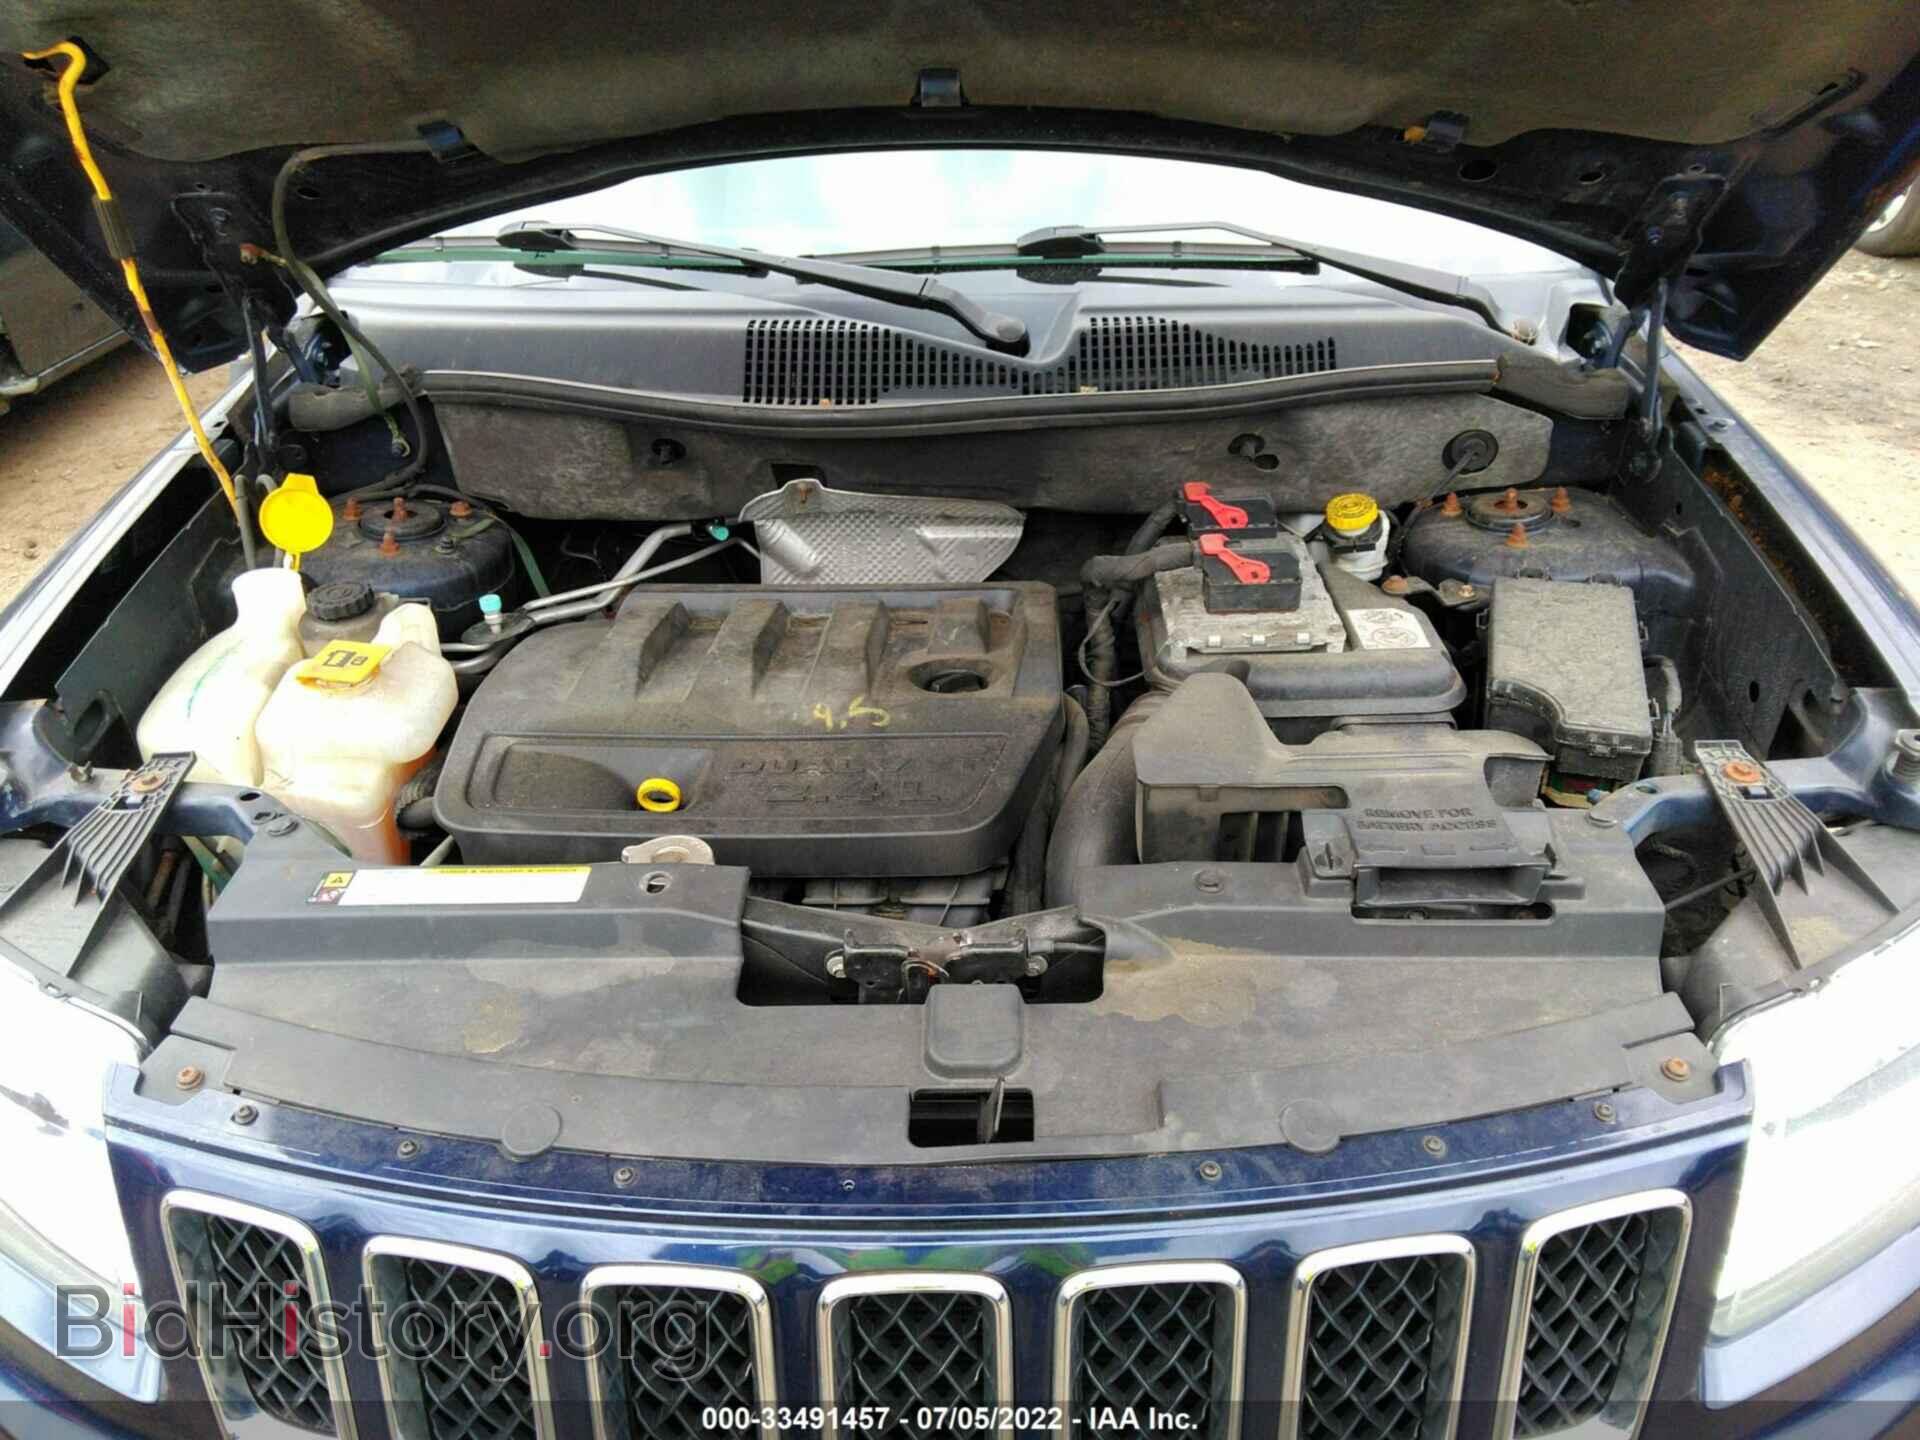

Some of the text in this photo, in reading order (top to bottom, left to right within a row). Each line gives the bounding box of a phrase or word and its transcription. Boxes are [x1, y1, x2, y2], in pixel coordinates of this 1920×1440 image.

[1363, 807, 1473, 819] REMOVE FOR
[1356, 819, 1497, 831] BATTERY ACCESS
